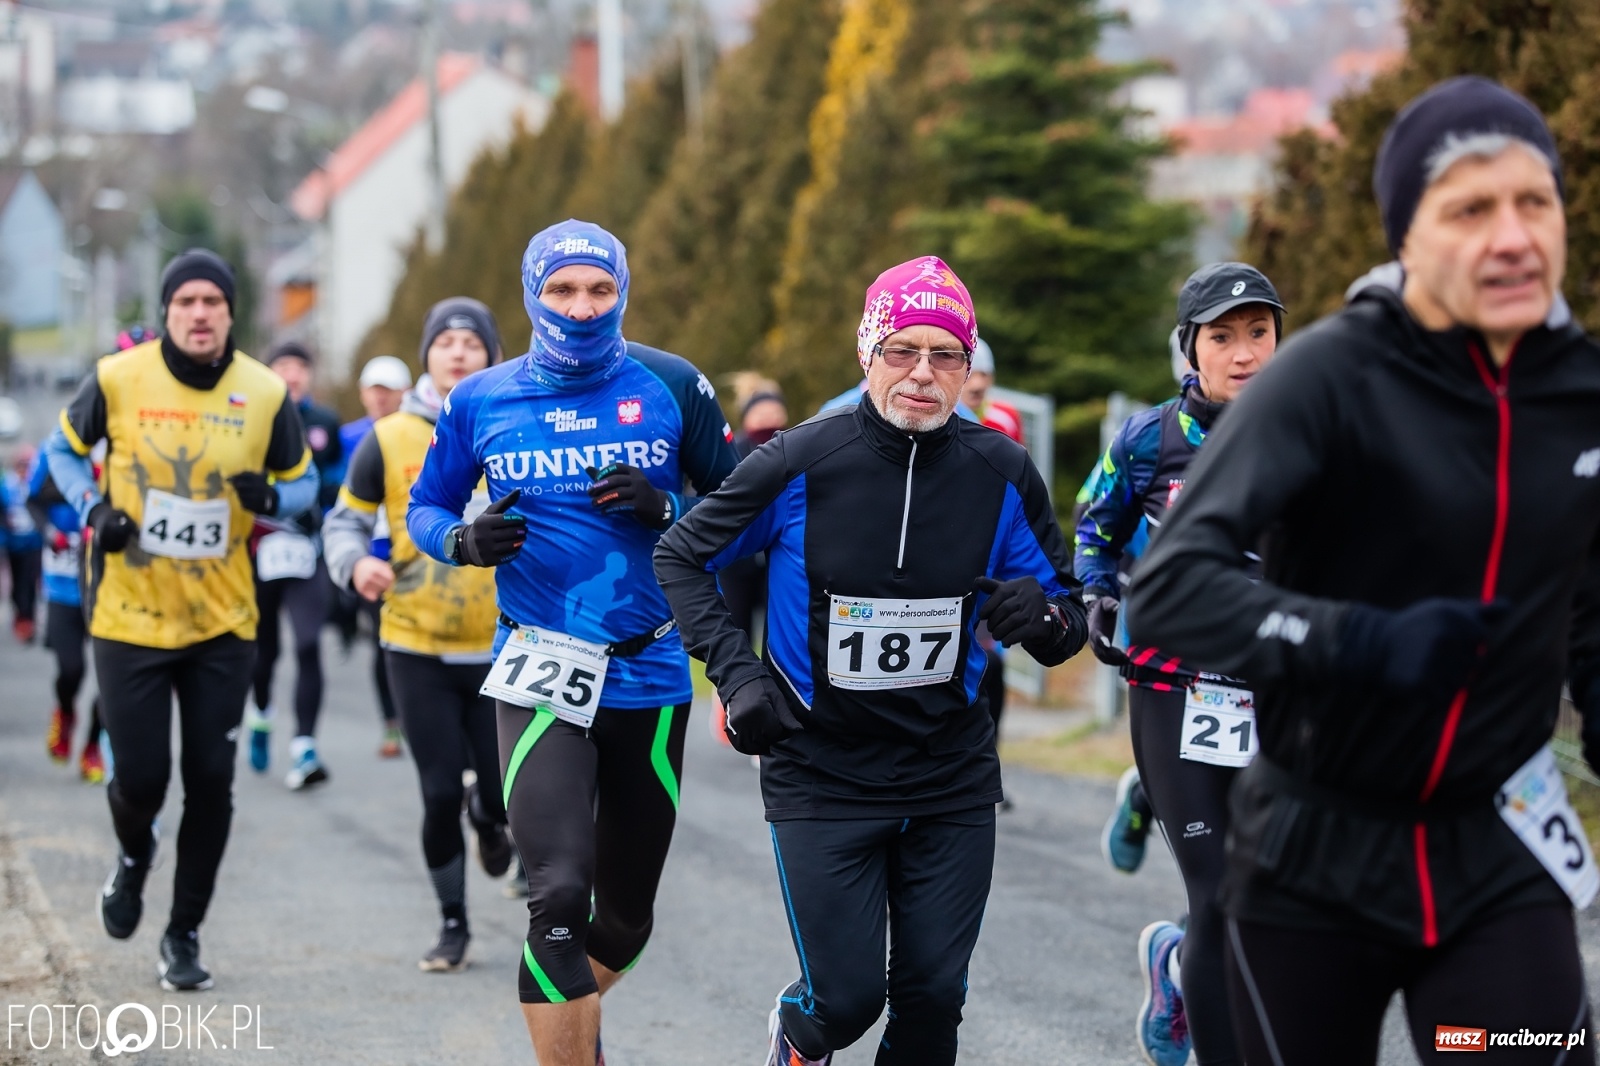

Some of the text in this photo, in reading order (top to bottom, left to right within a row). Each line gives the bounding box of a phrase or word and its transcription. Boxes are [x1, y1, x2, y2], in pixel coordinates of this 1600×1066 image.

[900, 291, 937, 313] XIII
[554, 417, 597, 433] okna
[485, 439, 670, 481] RUNNERS
[148, 519, 222, 547] 443
[879, 608, 957, 619] www.personalbest.pl
[838, 631, 953, 673] 187
[504, 653, 597, 707] 125
[1189, 714, 1252, 752] 21
[1543, 815, 1584, 870] 3
